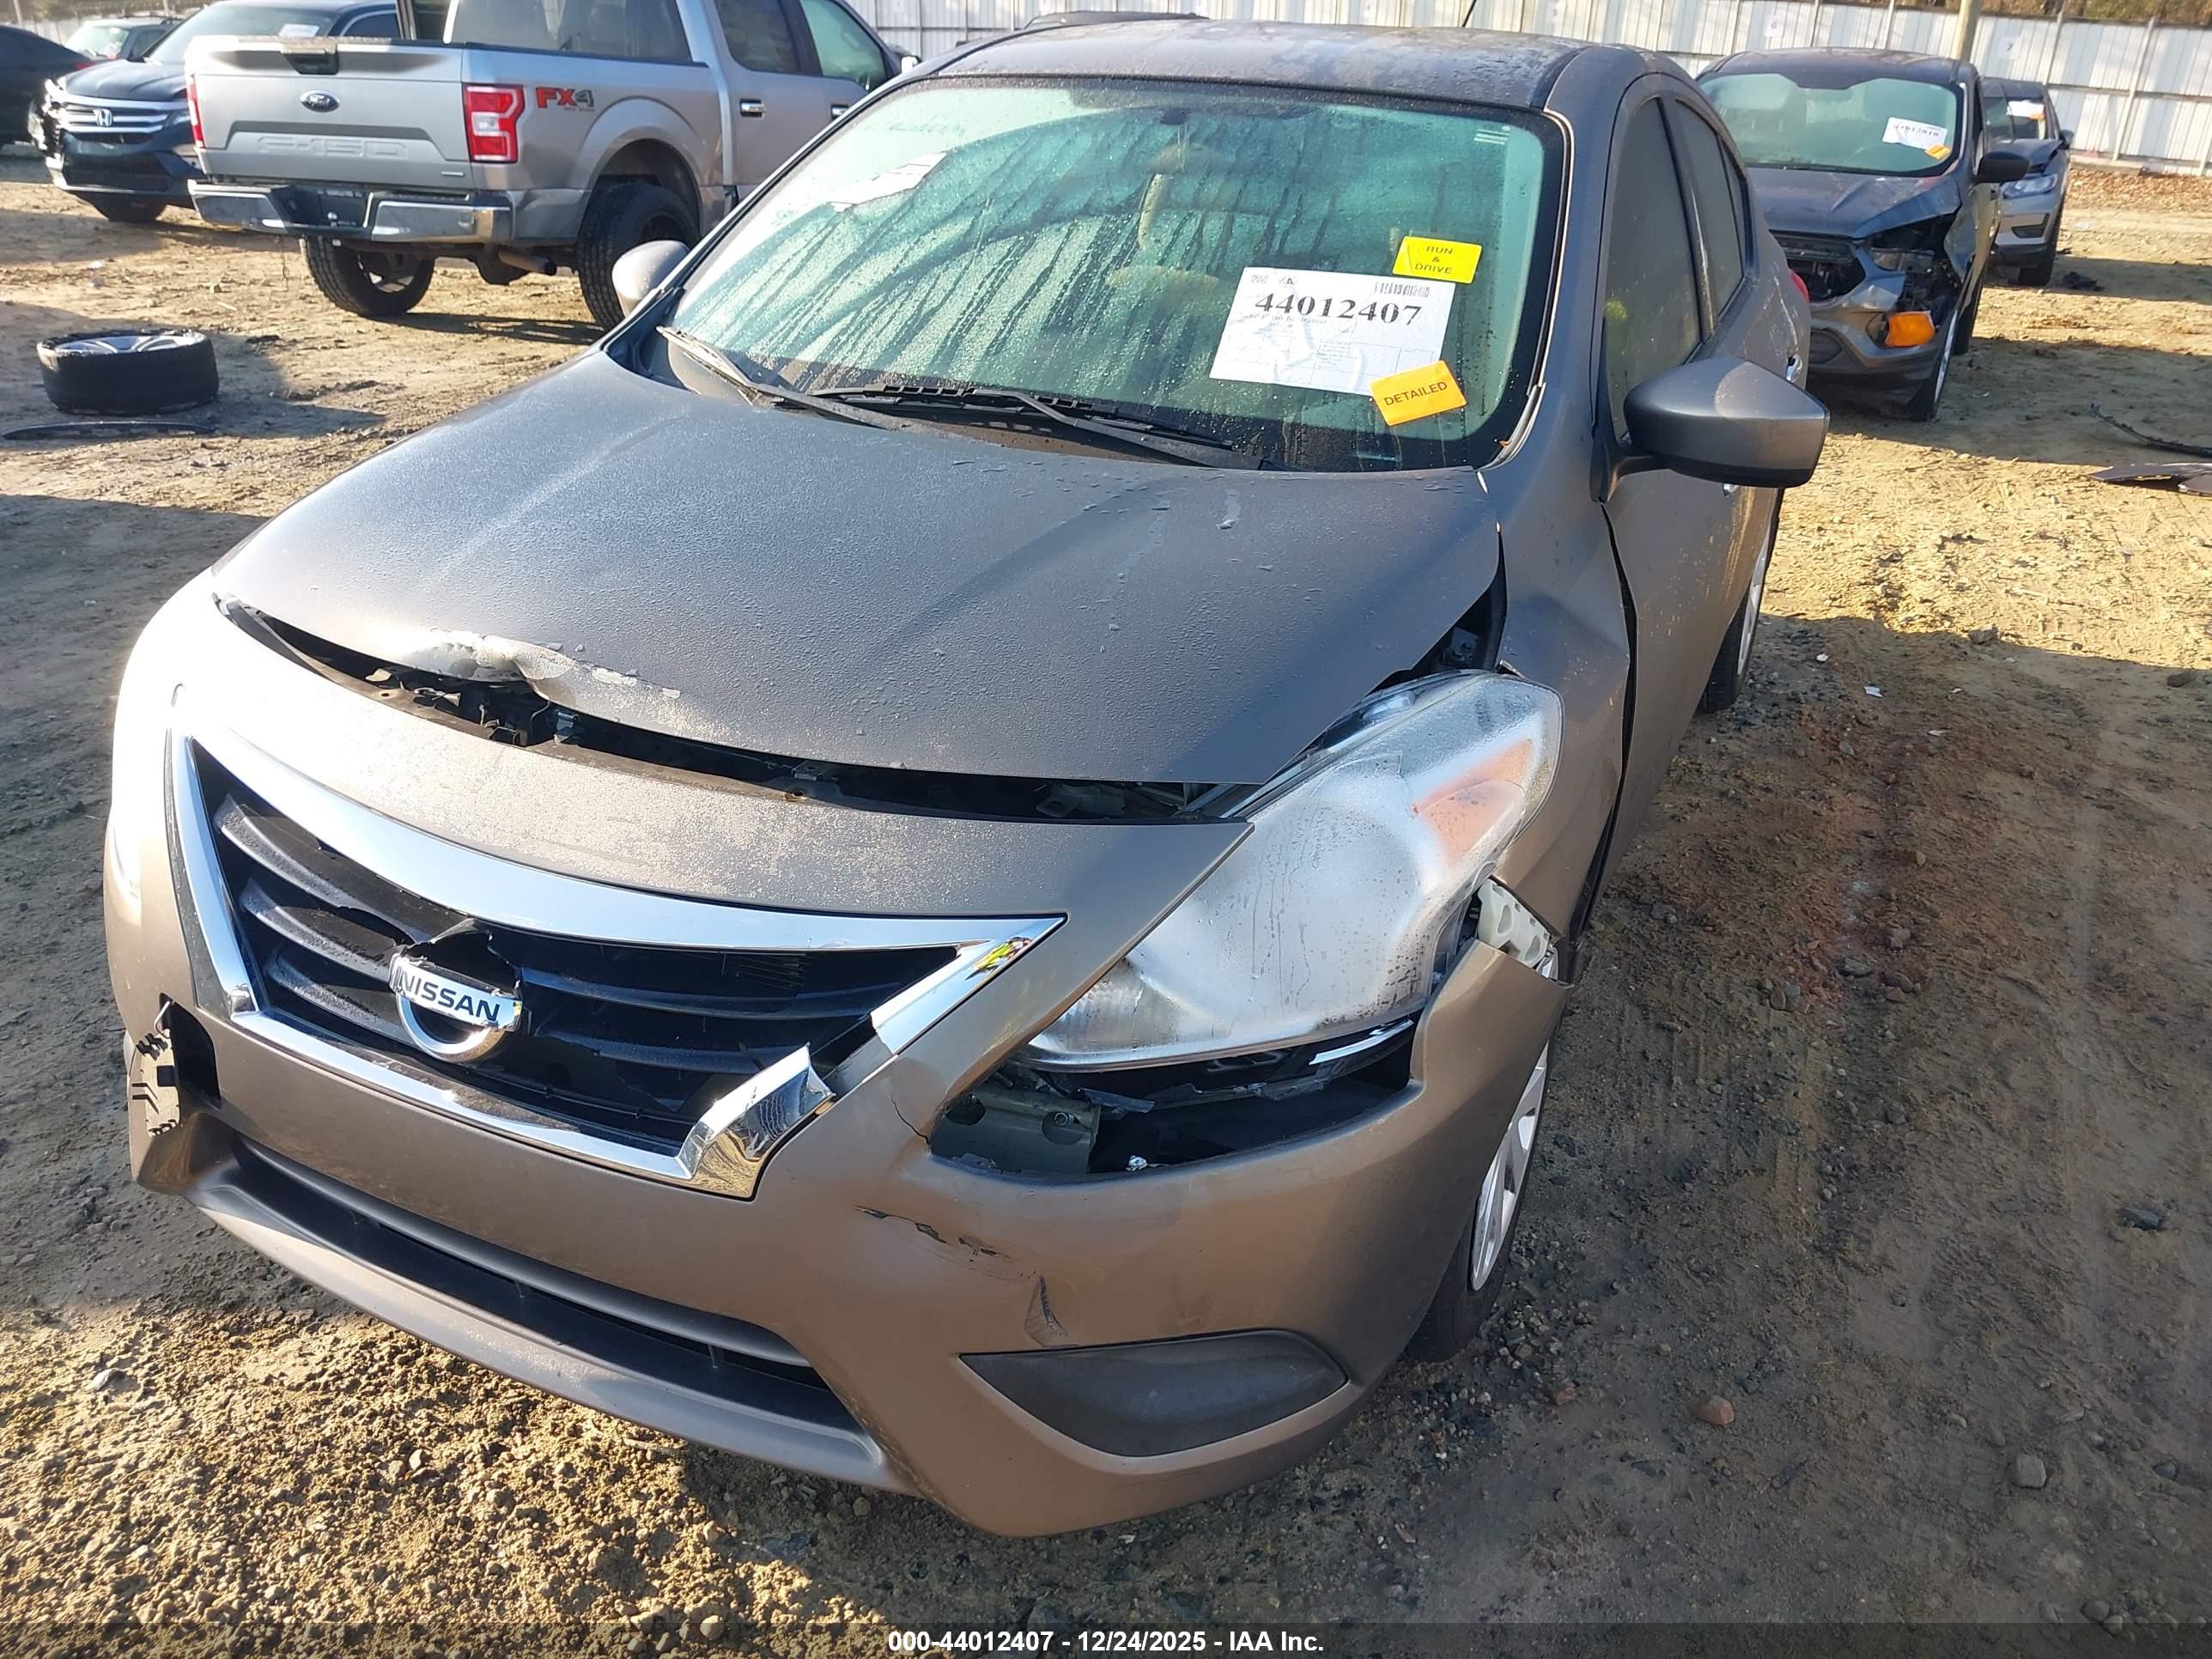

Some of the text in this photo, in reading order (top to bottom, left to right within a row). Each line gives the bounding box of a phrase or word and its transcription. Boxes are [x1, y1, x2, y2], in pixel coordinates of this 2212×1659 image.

[535, 87, 594, 108] FX4
[1425, 246, 1453, 255] RUN
[1414, 263, 1453, 275] DRIVE
[1255, 293, 1422, 326] 44012407
[1383, 381, 1448, 406] DETAILED
[399, 968, 501, 1022] NISSAN
